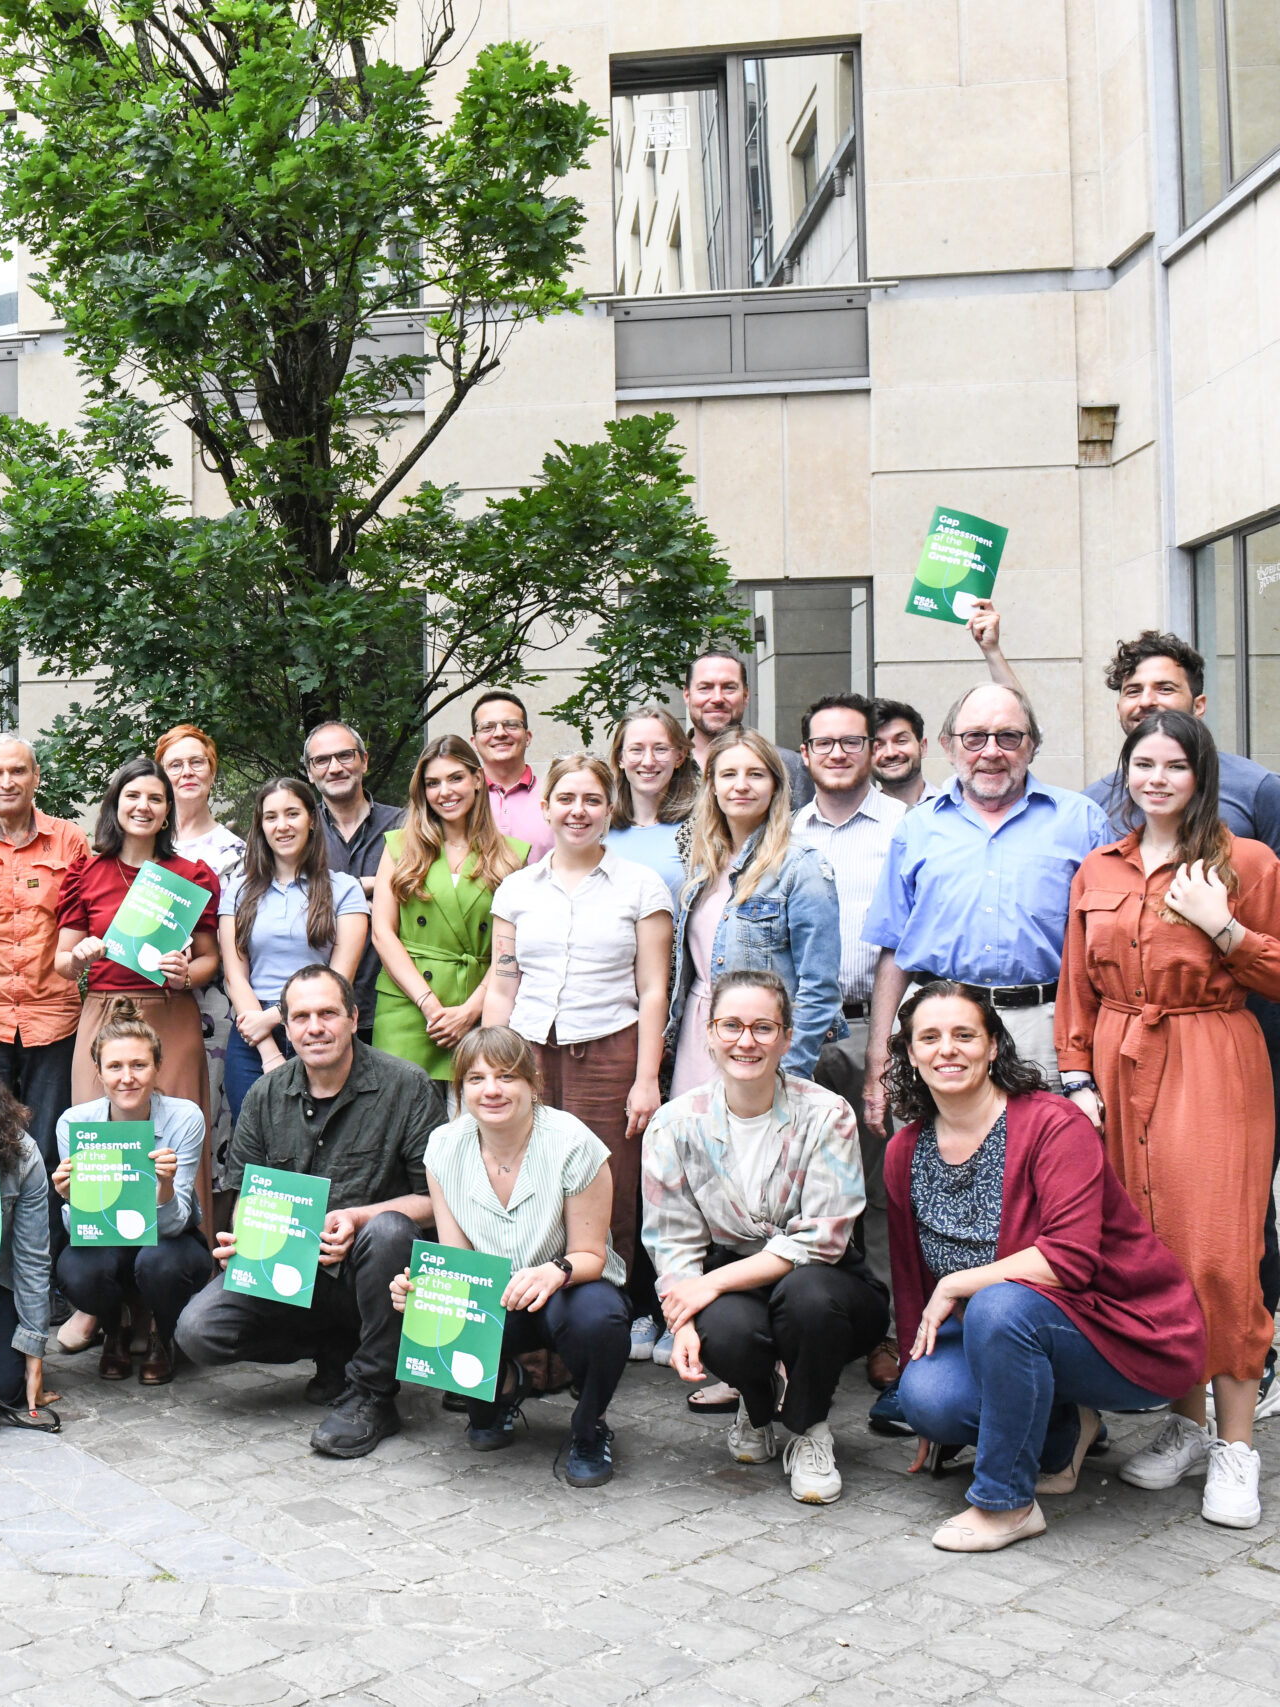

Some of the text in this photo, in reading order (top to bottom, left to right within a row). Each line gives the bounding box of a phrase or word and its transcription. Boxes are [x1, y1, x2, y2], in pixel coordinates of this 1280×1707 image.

[939, 515, 959, 527] Gap
[933, 533, 962, 545] of the
[936, 524, 993, 547] Assessment
[930, 542, 981, 561] European
[928, 551, 986, 572] Green Deal
[144, 869, 162, 882] Gap
[140, 877, 192, 908] Assessment
[156, 914, 178, 931] Deal
[76, 1130, 98, 1141] Gap
[76, 1141, 142, 1150] Assessment
[76, 1151, 106, 1160] of the
[76, 1162, 131, 1172] European
[76, 1172, 140, 1181] Green Deal
[250, 1174, 272, 1187] Gap
[246, 1195, 276, 1209] of the
[248, 1185, 313, 1206] Assessment
[244, 1206, 299, 1226] European
[242, 1217, 306, 1238] Green Deal
[420, 1252, 445, 1266] Gap
[418, 1264, 494, 1288] Assessment
[416, 1276, 452, 1291] of the
[415, 1287, 478, 1309] European
[413, 1299, 486, 1324] Green Deal
[406, 1356, 430, 1367] REAL
